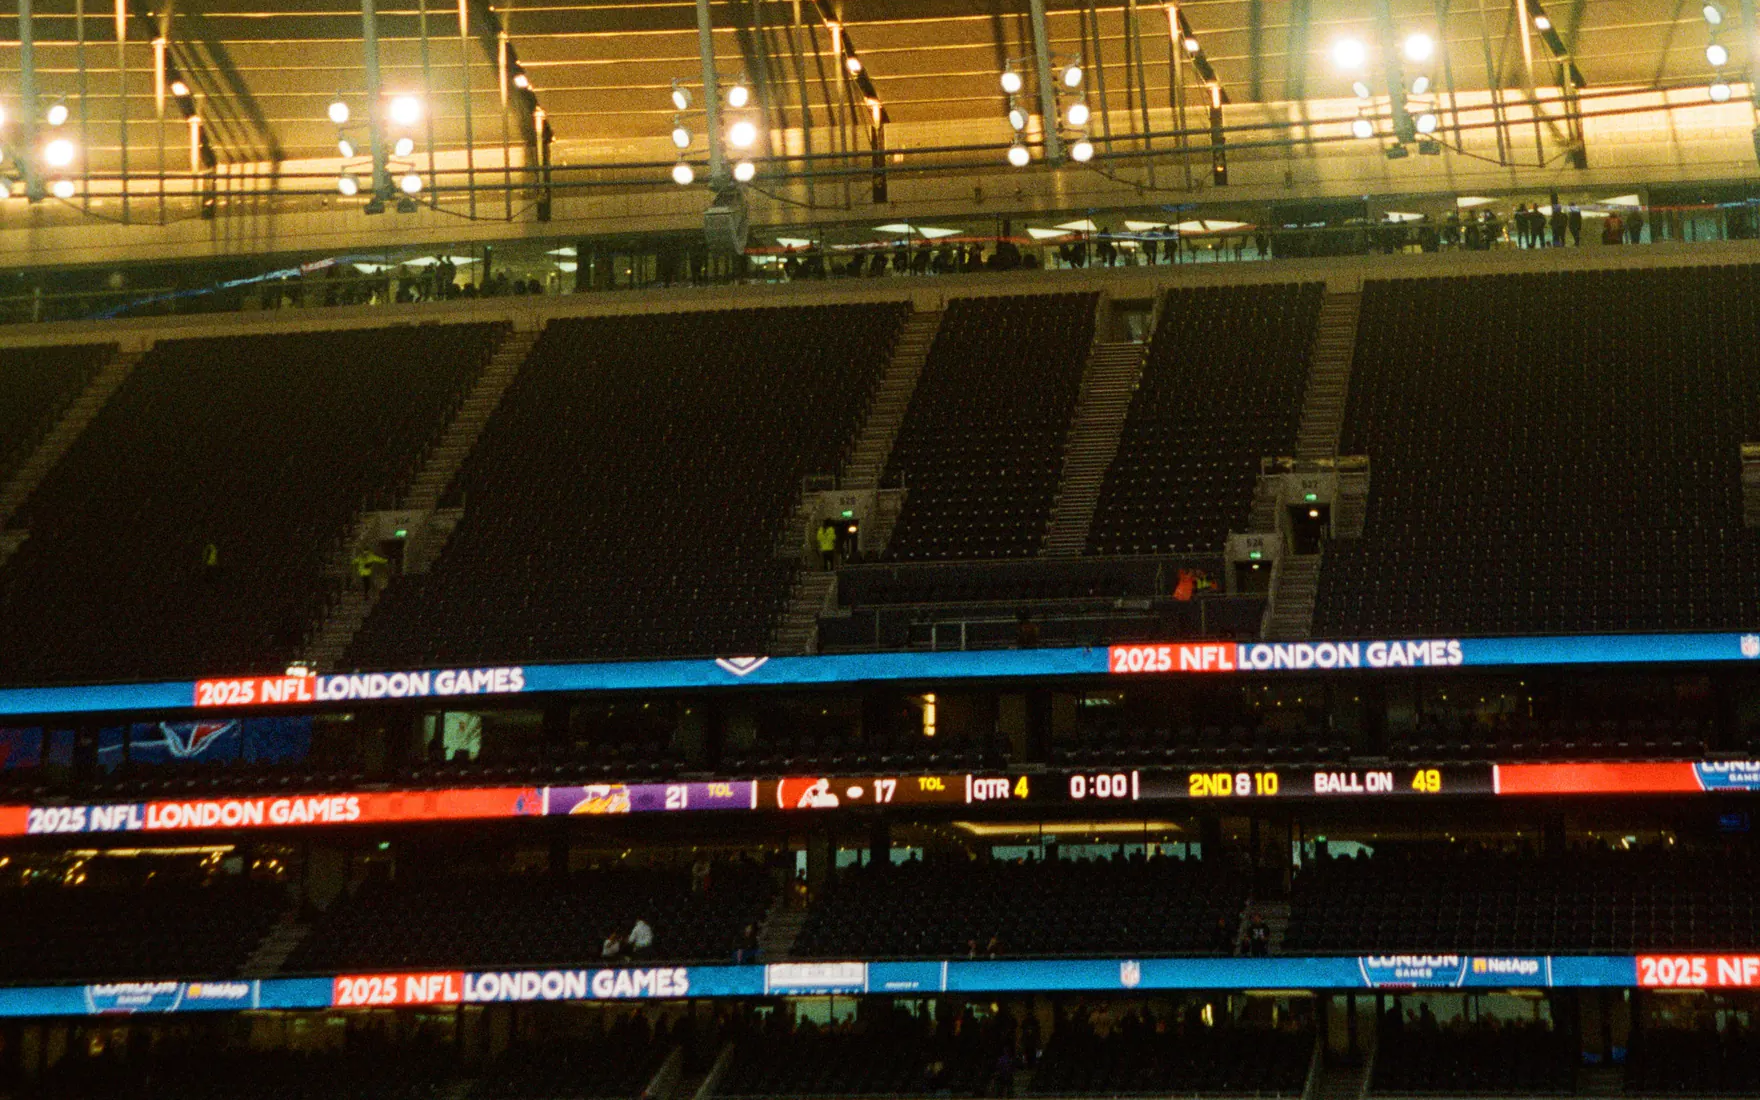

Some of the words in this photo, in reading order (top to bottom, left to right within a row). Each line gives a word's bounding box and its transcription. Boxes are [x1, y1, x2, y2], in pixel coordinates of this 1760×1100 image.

[1113, 646, 1172, 673] 2025
[1179, 645, 1234, 671] NFL
[1237, 642, 1360, 670] LONDON
[1365, 640, 1463, 667] GAMES
[199, 680, 255, 706] 2025
[260, 677, 312, 703] NFL
[314, 671, 431, 701] LONDON
[434, 667, 526, 696] GAMES
[873, 779, 897, 803] 17
[918, 776, 946, 791] TOL
[973, 779, 1010, 800] QTR
[1014, 775, 1029, 798] 4
[1070, 774, 1127, 799] 0:00
[1189, 773, 1233, 797] 2ND
[1254, 772, 1278, 796] 10
[1314, 772, 1363, 793] BALL
[1365, 771, 1394, 793] ON
[1411, 769, 1441, 793] 49
[665, 784, 689, 810] 21
[706, 782, 735, 798] TOL
[27, 806, 87, 834] 2025
[89, 804, 143, 832] NFL
[146, 800, 263, 829] LONDON
[268, 797, 360, 825] GAMES
[1488, 958, 1539, 975] NetApp
[1640, 957, 1709, 986] 2025
[337, 976, 398, 1006] 2025
[404, 974, 459, 1003] NFL
[462, 971, 588, 1001] LONDON
[591, 967, 690, 998] GAMES
